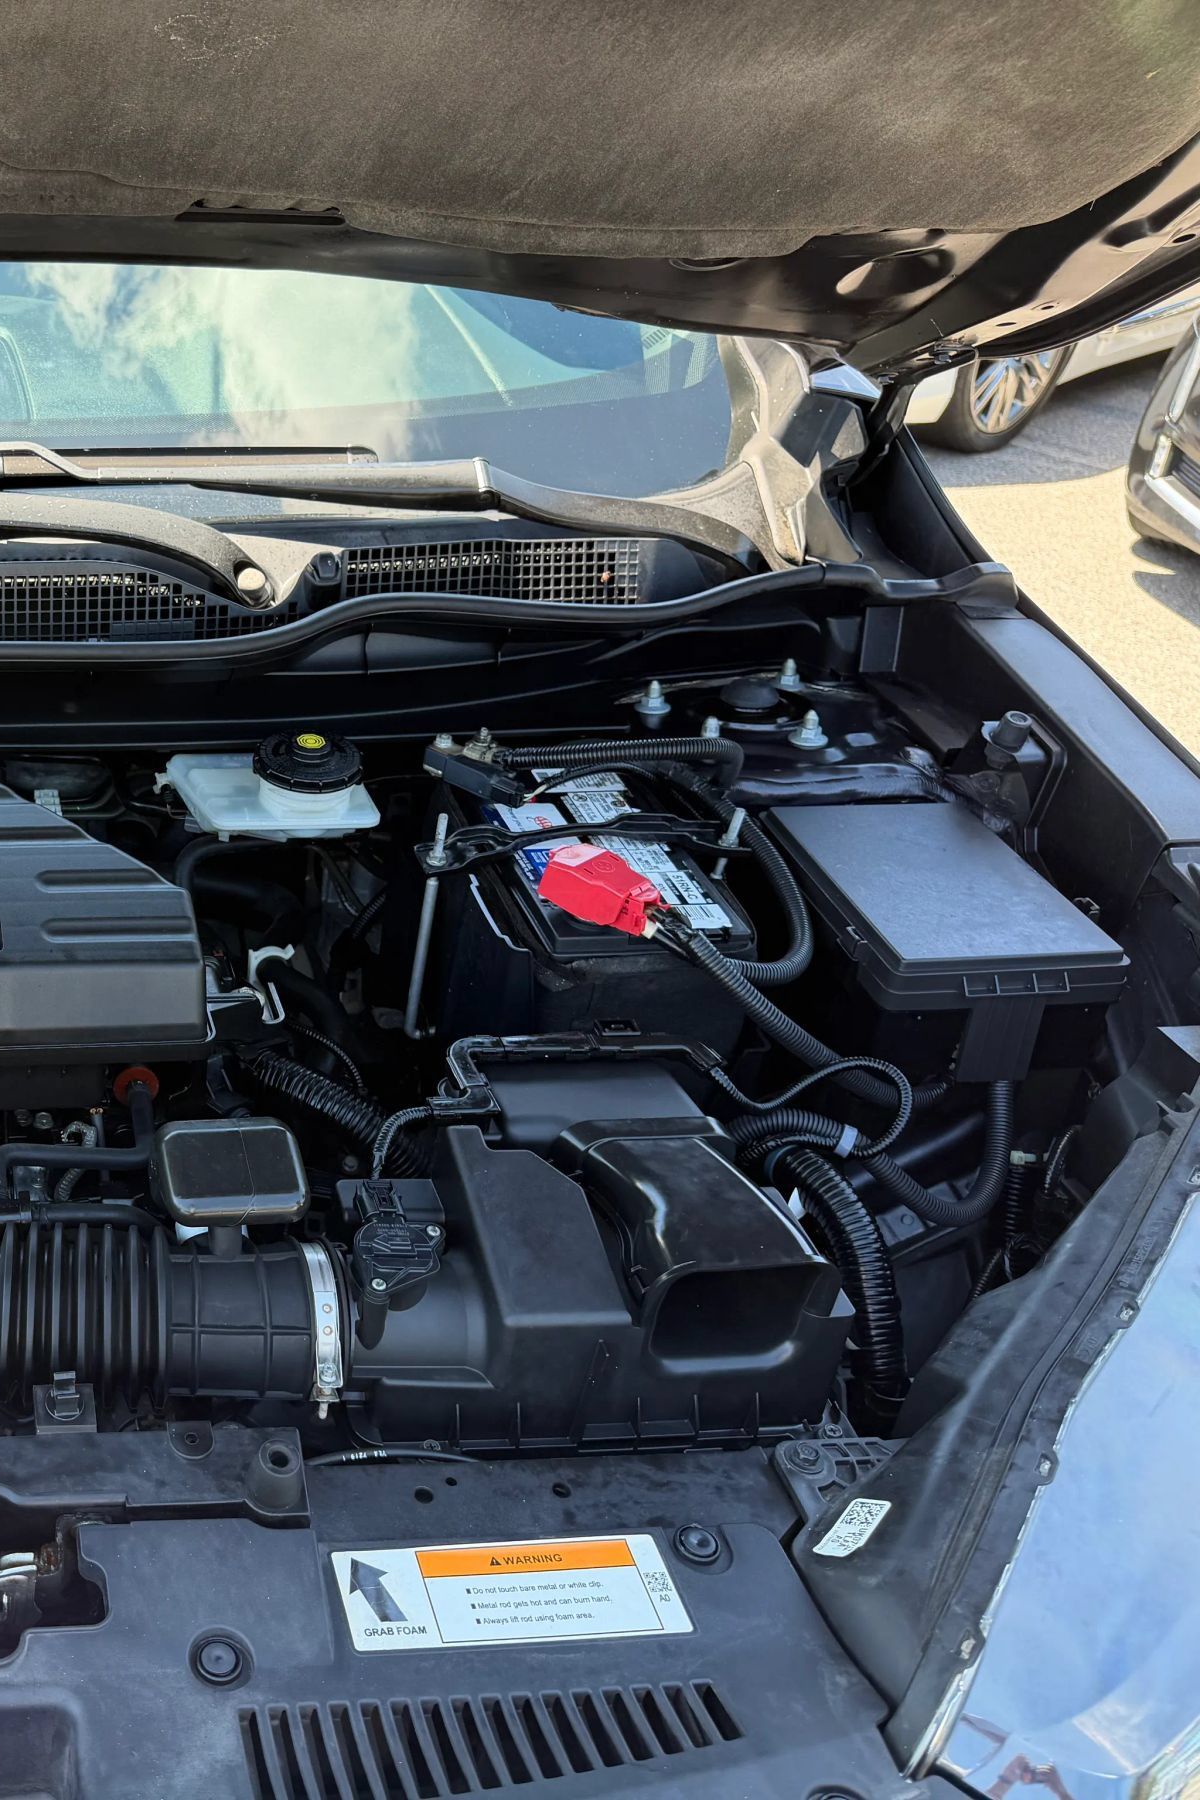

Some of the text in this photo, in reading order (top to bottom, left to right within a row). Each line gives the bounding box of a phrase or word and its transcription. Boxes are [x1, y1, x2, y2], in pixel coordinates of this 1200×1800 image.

[502, 1553, 563, 1566] WARNING
[472, 1587, 483, 1595] Do
[485, 1586, 497, 1594] not
[498, 1585, 518, 1594] touch
[519, 1584, 536, 1592] bare
[537, 1583, 557, 1591] metal
[567, 1581, 587, 1590] white
[588, 1580, 604, 1590] clip.
[477, 1595, 613, 1610] Metal rod gets hot and can burn hand.
[659, 1594, 671, 1602] A0
[482, 1611, 595, 1626] Always lift rod using foam area.
[364, 1625, 428, 1637] GRAB FOAM
